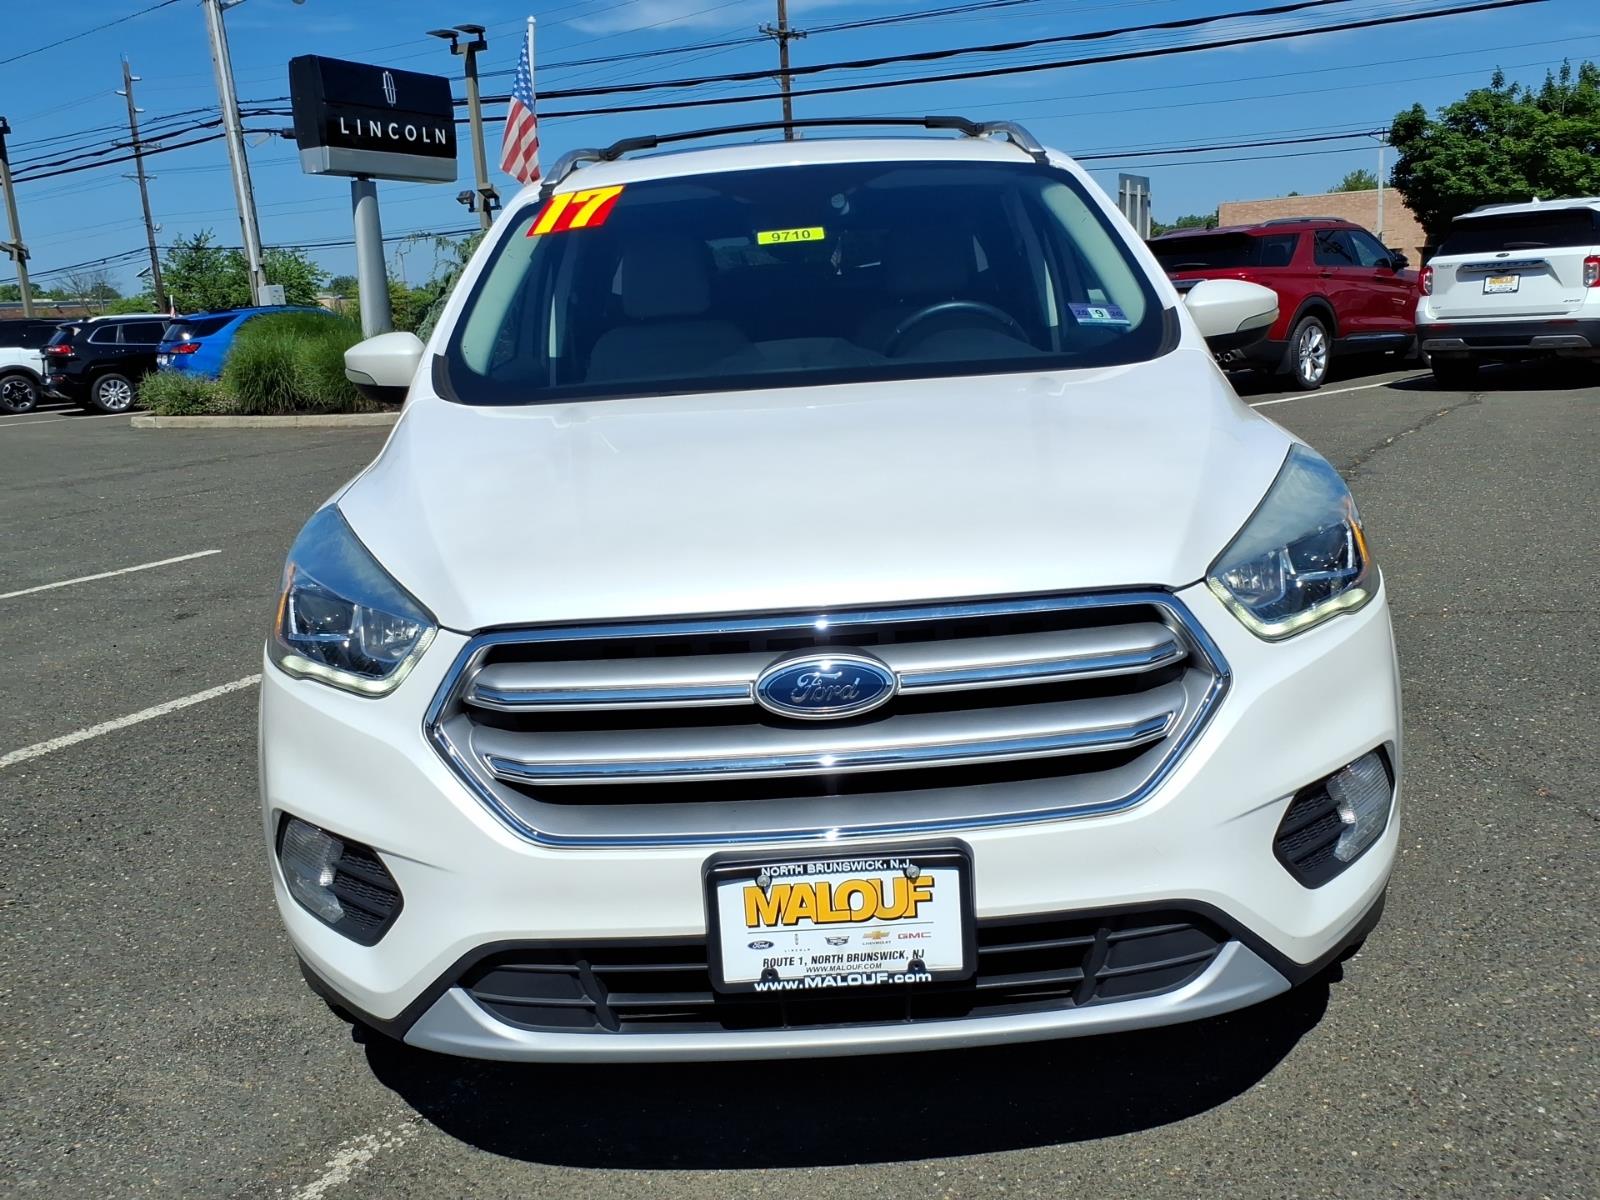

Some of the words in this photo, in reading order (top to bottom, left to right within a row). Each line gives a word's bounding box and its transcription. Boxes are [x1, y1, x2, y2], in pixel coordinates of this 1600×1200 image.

[339, 116, 447, 145] LINCOLN
[532, 184, 625, 235] 17
[771, 230, 811, 242] 9710
[790, 671, 861, 704] Ford
[761, 863, 804, 877] NORTH
[807, 859, 887, 874] BRUNSWICK,
[743, 875, 935, 928] MALOUF
[897, 931, 932, 940] GMC
[763, 956, 795, 968] ROUTE
[811, 953, 844, 965] NORTH
[846, 949, 909, 964] BRUNSWICK,
[912, 948, 925, 960] NJ
[806, 962, 882, 973] WWW.MALOUF.COM
[754, 972, 932, 992] www.MALOUF.com
